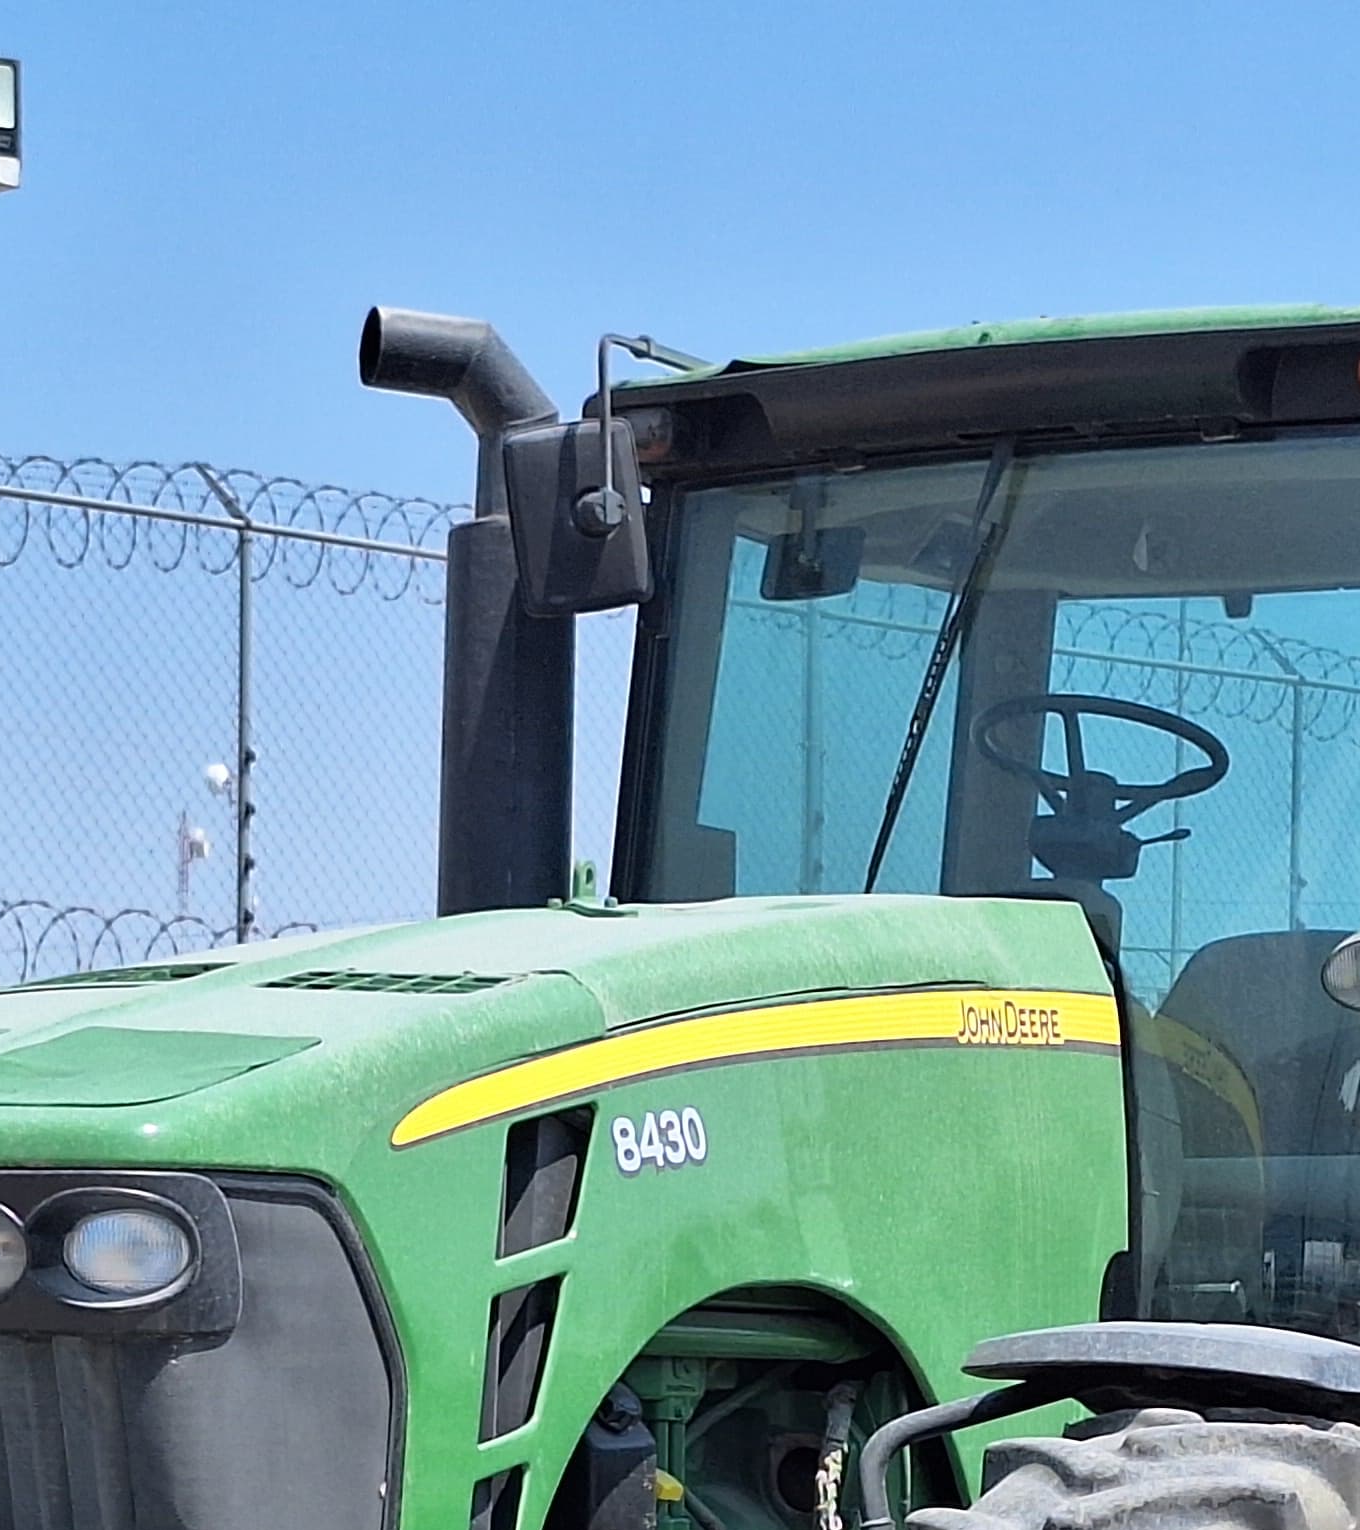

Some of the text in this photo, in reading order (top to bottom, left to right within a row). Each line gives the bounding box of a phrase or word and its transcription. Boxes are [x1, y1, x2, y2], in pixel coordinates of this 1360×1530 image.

[958, 999, 1061, 1038] JOHN DEERE
[612, 1106, 707, 1172] 8430
